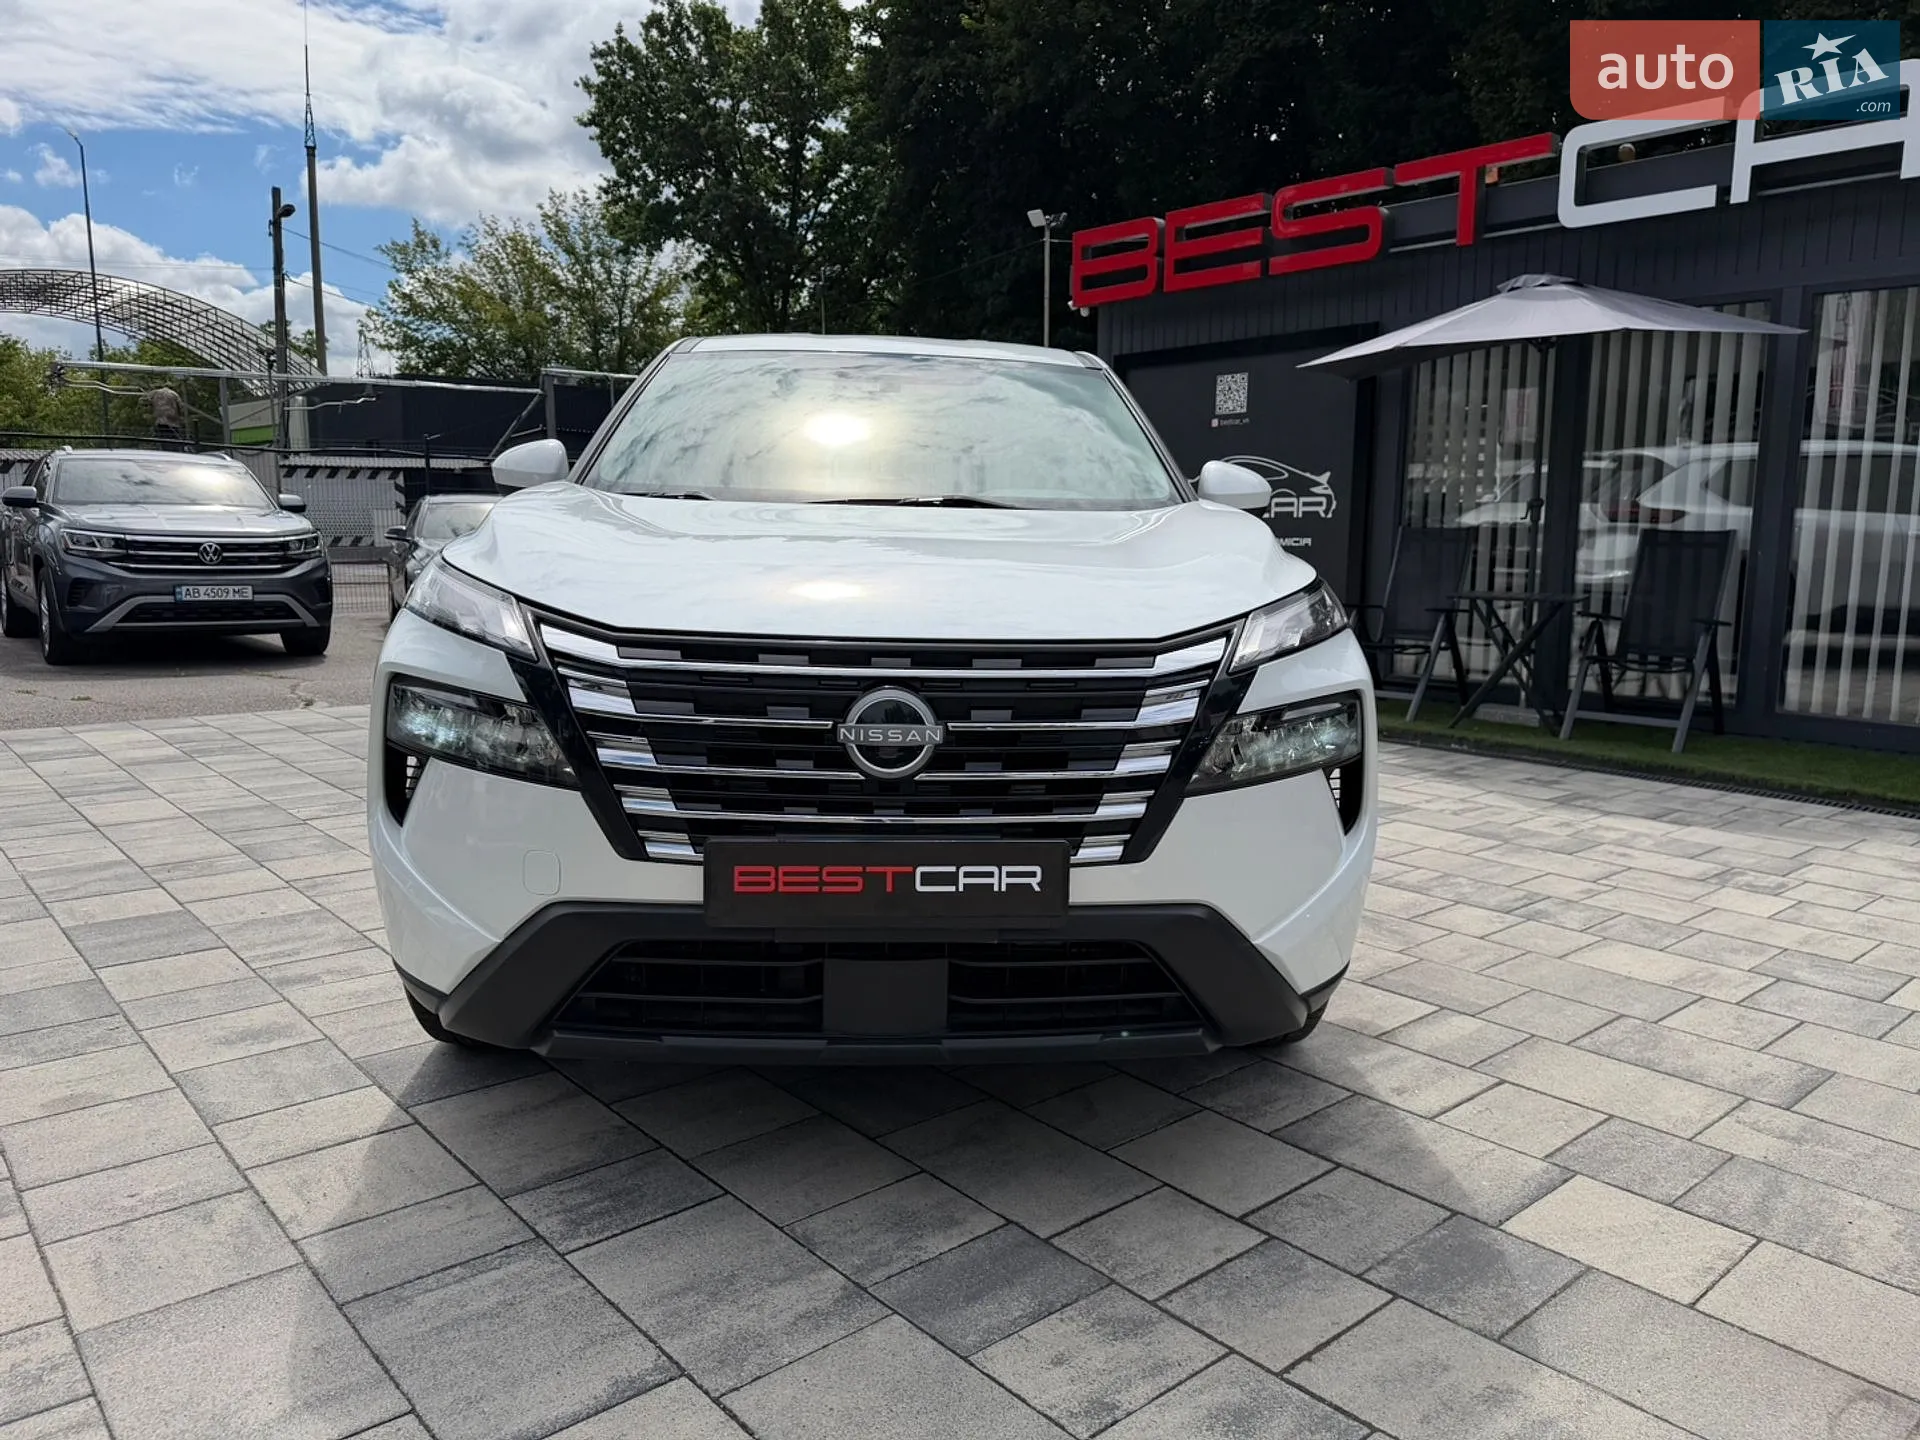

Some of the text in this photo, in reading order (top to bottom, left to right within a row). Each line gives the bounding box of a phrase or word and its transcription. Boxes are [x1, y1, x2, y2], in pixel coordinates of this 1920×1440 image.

[1262, 496, 1327, 518] AR
[184, 587, 250, 600] AB 4509 ME
[840, 728, 940, 742] NISSAN
